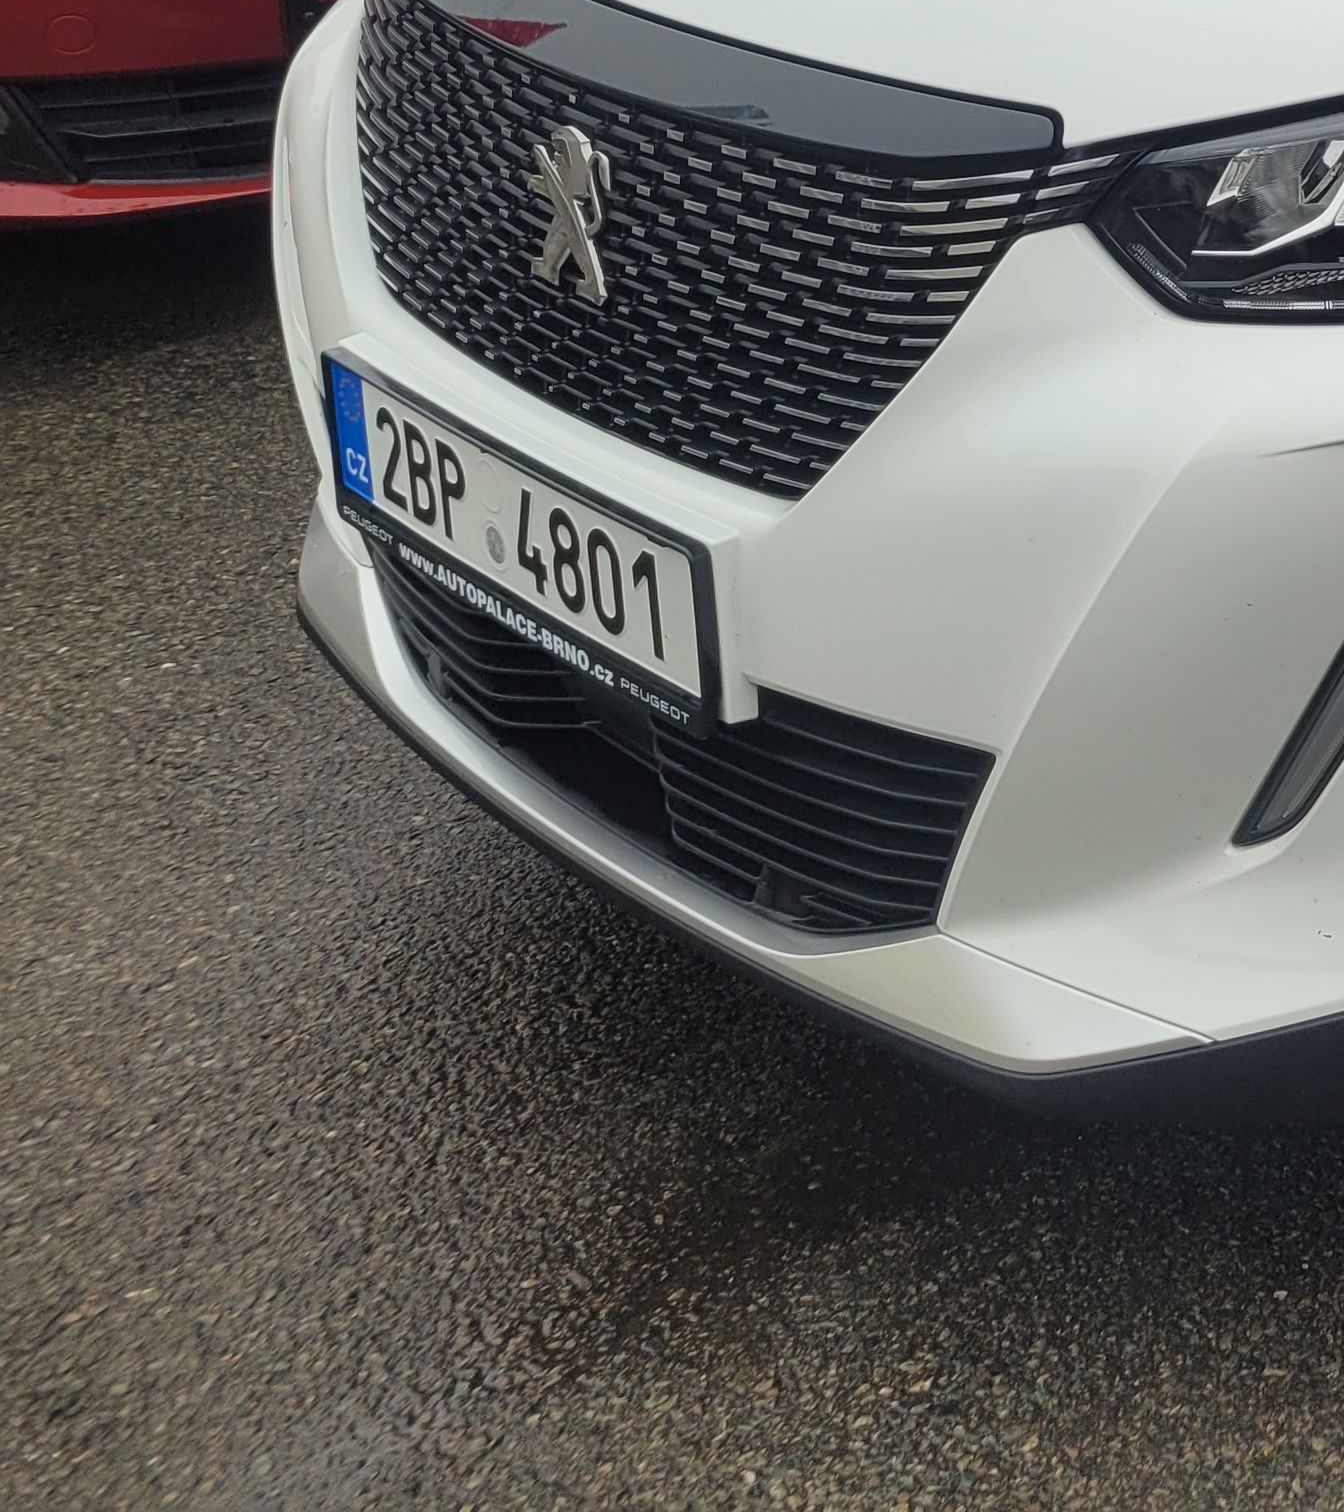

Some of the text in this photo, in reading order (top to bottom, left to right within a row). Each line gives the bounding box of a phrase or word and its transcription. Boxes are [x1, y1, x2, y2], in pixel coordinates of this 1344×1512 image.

[345, 447, 370, 485] CZ
[376, 406, 666, 663] 2BP 4801
[343, 504, 394, 546] PEUGEOT
[620, 676, 691, 726] PEUGEOT
